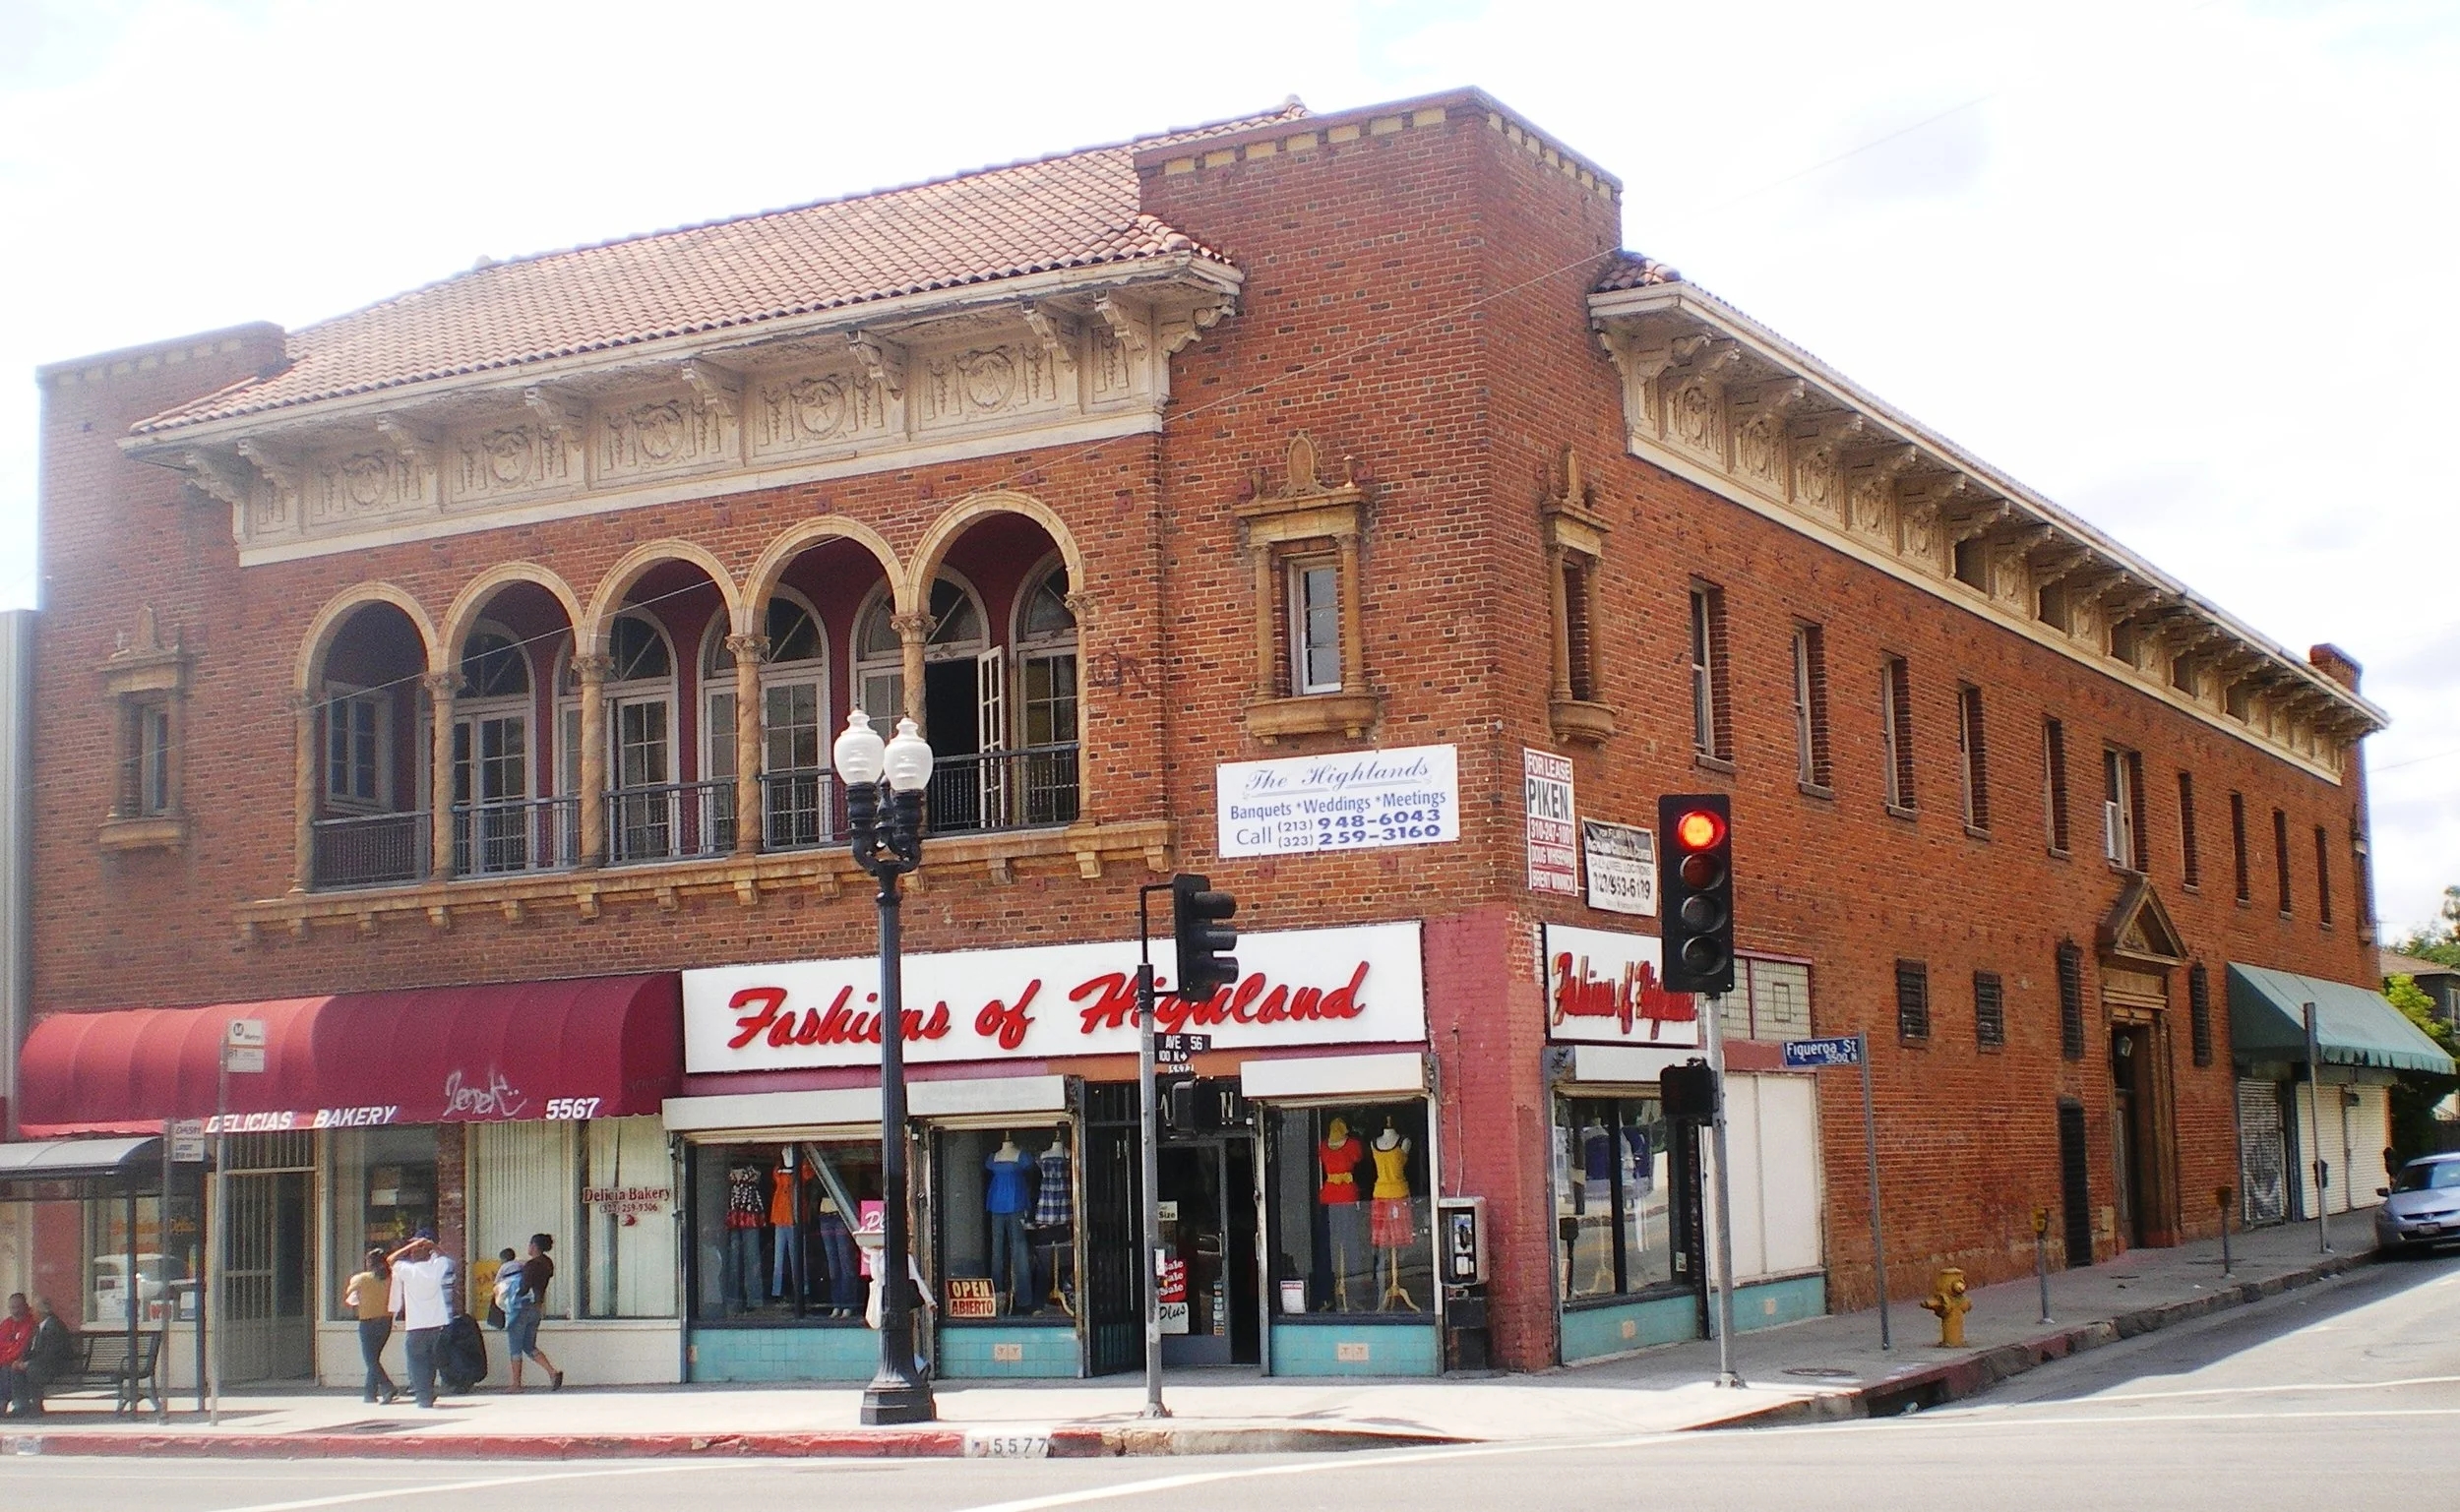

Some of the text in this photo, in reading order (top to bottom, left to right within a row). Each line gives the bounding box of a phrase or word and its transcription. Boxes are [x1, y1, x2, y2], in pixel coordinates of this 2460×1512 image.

[1245, 756, 1429, 791] The Highlands
[1527, 754, 1570, 782] FOR LEASE
[1528, 778, 1568, 821] PIKEN
[1230, 802, 1292, 820] Banquets
[1277, 809, 1442, 833] (213) 948-6043
[1236, 824, 1442, 849] Call (323) 259-3160
[975, 979, 1042, 1051] of
[1165, 1035, 1202, 1051] AVE 56
[1786, 1039, 1857, 1061] Figueroa St
[1158, 1050, 1171, 1062] 100
[546, 1097, 600, 1120] 5567
[206, 1105, 399, 1134] DELICIAS BAKERY
[584, 1186, 671, 1202] Delicia Bakery
[1158, 1210, 1176, 1219] Size
[952, 1281, 990, 1299] OPEN
[1159, 1283, 1184, 1296] Sale
[952, 1300, 993, 1316] ABIERTO
[1159, 1305, 1186, 1321] Plus
[994, 1437, 1048, 1454] 5577
